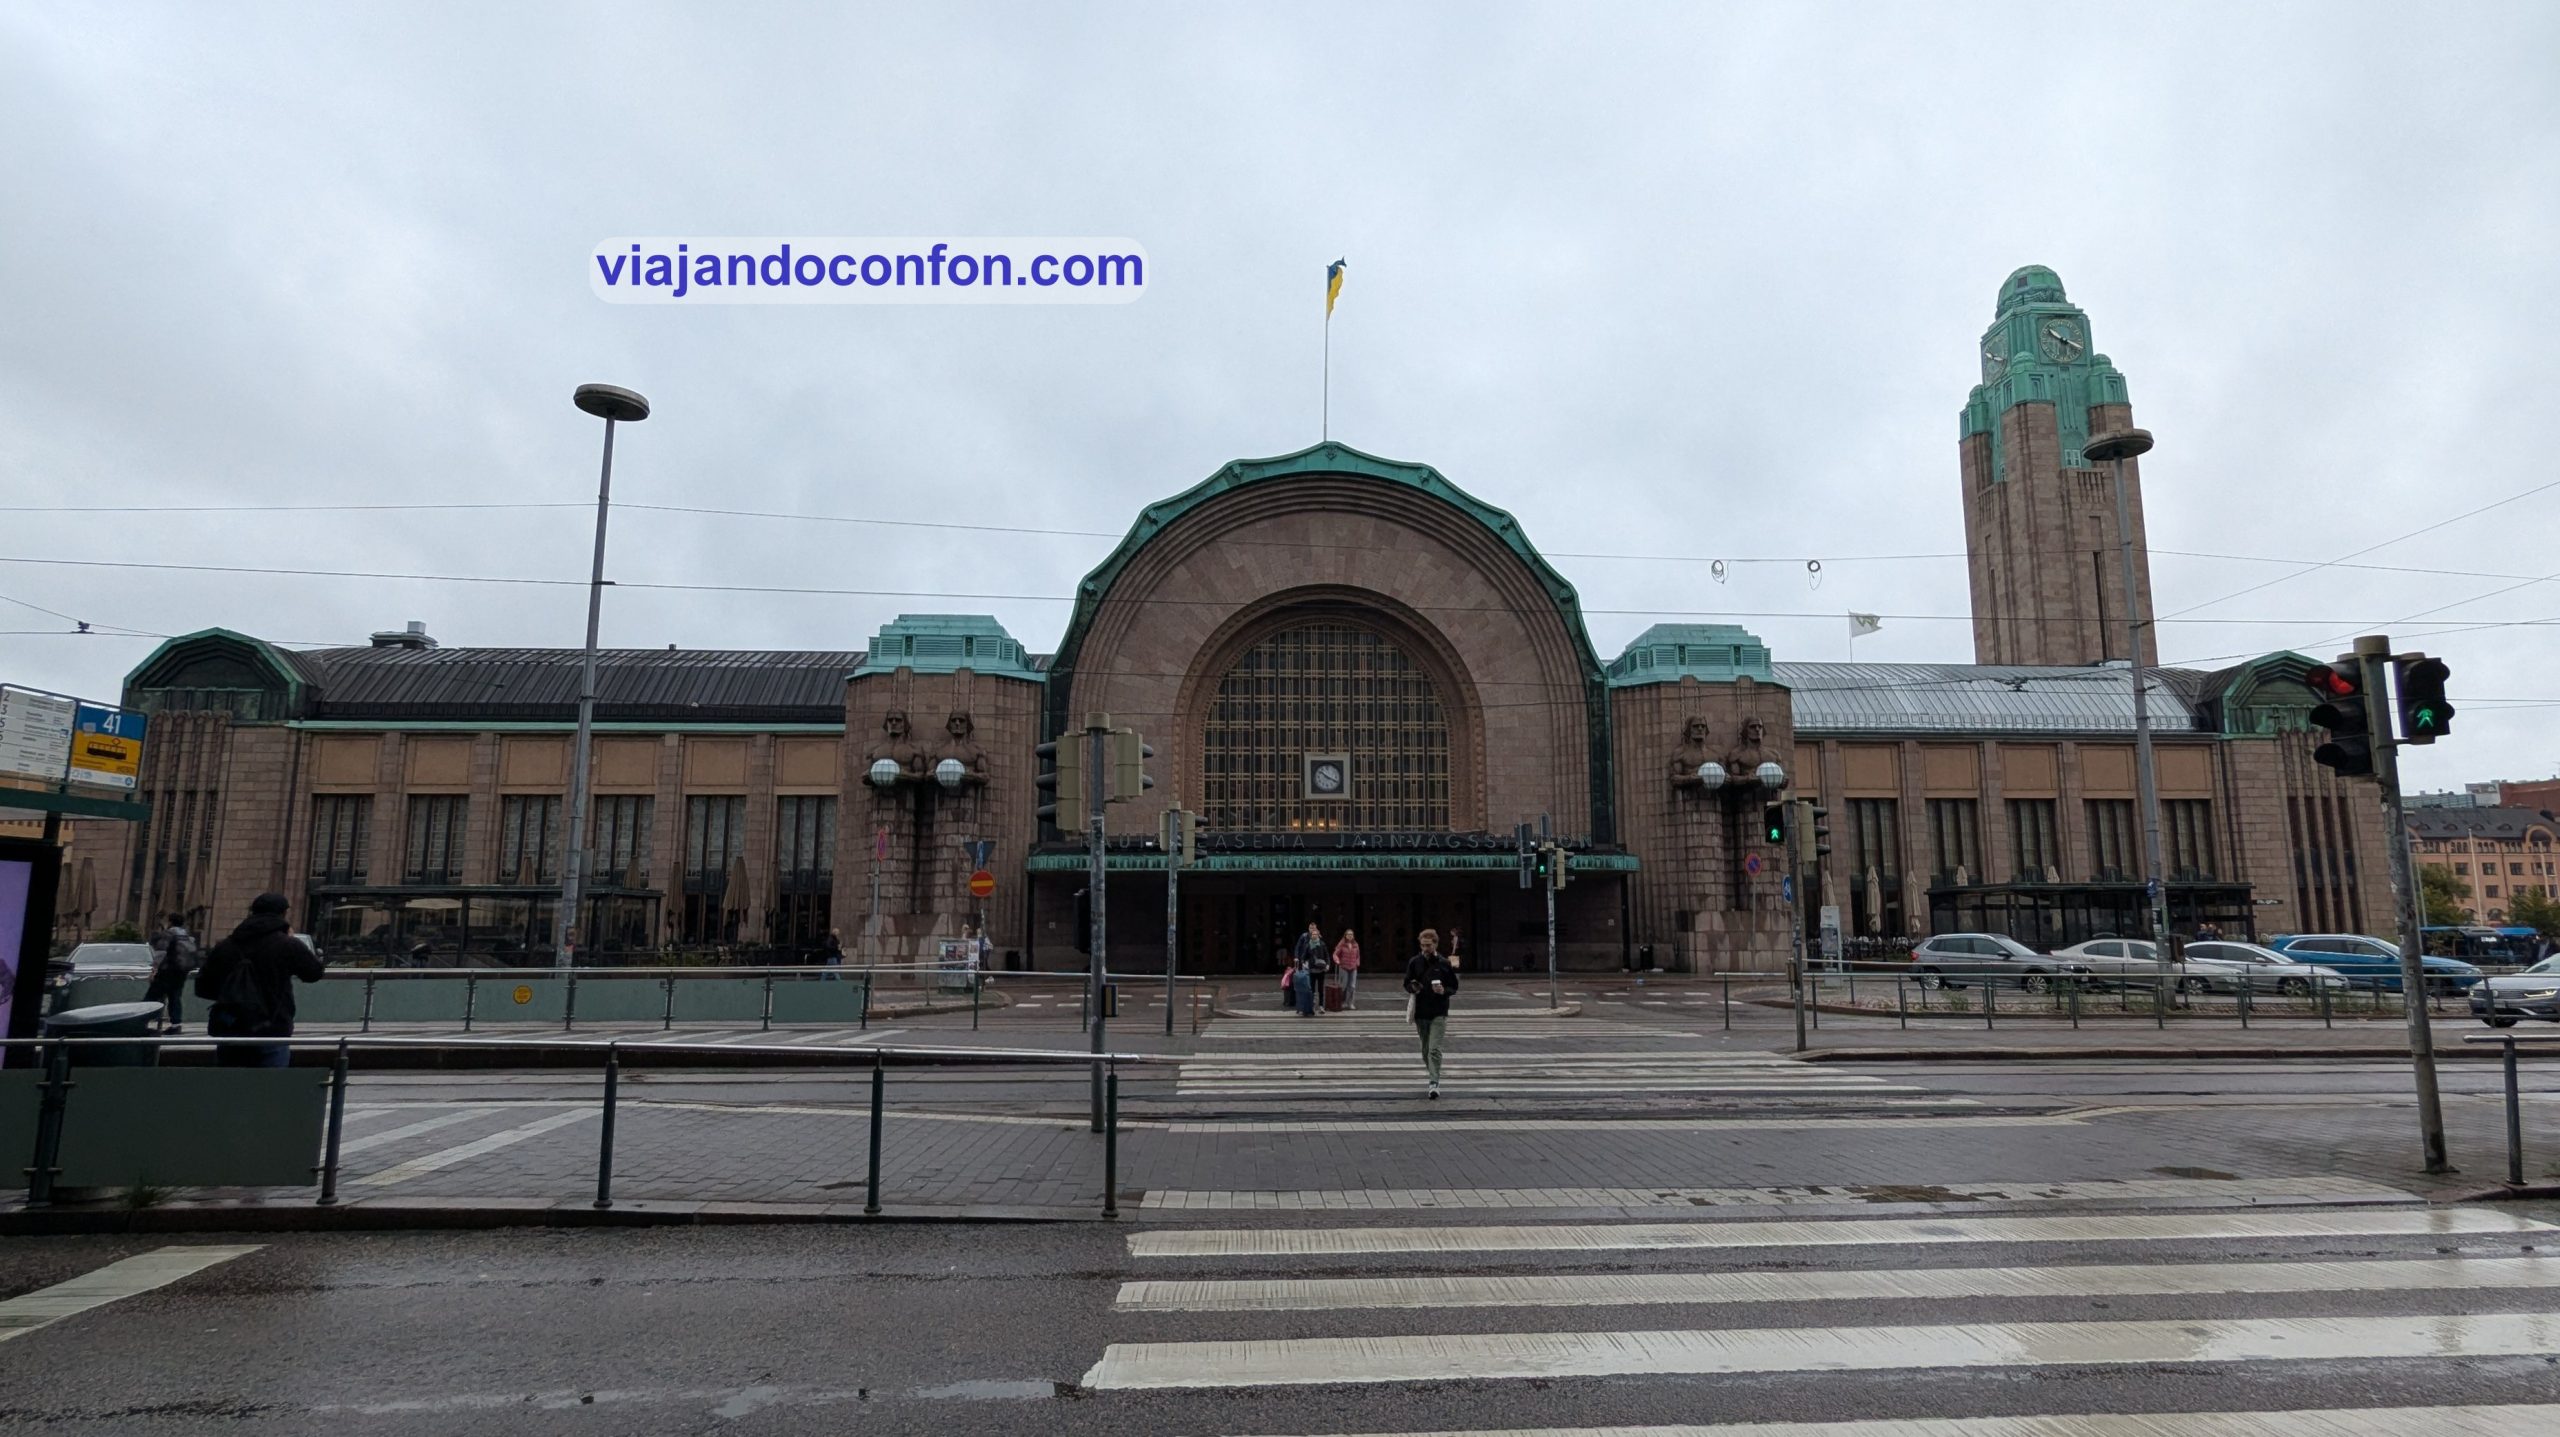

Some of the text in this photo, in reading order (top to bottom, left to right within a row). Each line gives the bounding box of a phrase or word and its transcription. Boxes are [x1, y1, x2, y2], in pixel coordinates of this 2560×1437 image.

[103, 713, 122, 735] 41
[1080, 832, 1592, 849] RUTAASEMA JÄRNVÄGSSTTON
